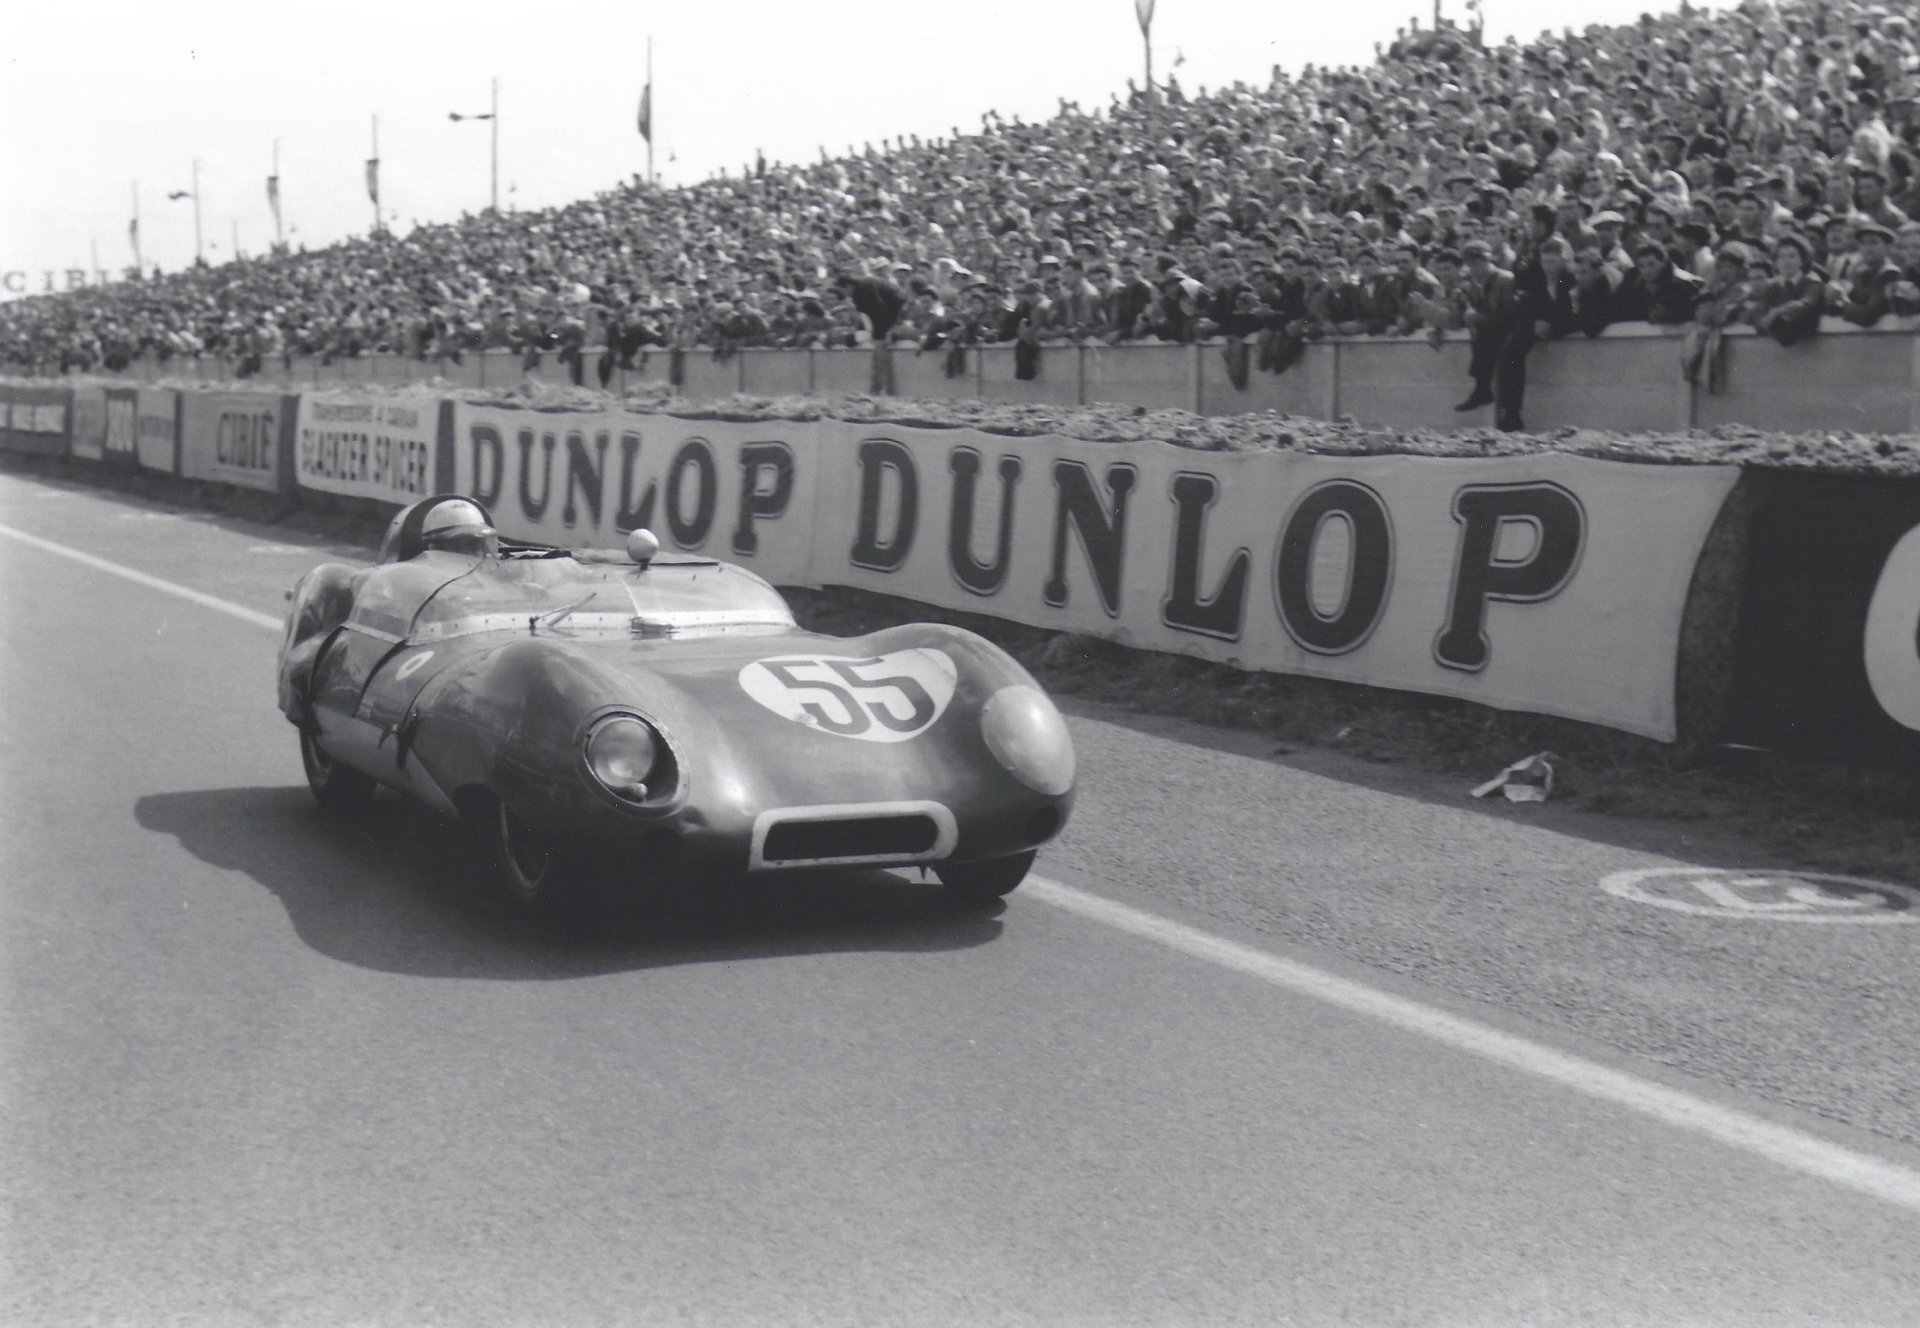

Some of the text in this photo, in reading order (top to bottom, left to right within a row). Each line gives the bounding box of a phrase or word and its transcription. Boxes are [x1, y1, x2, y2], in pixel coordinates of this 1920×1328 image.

[470, 422, 796, 556] DUNLOP
[850, 438, 1587, 672] DUNLOP
[757, 657, 935, 735] 55
